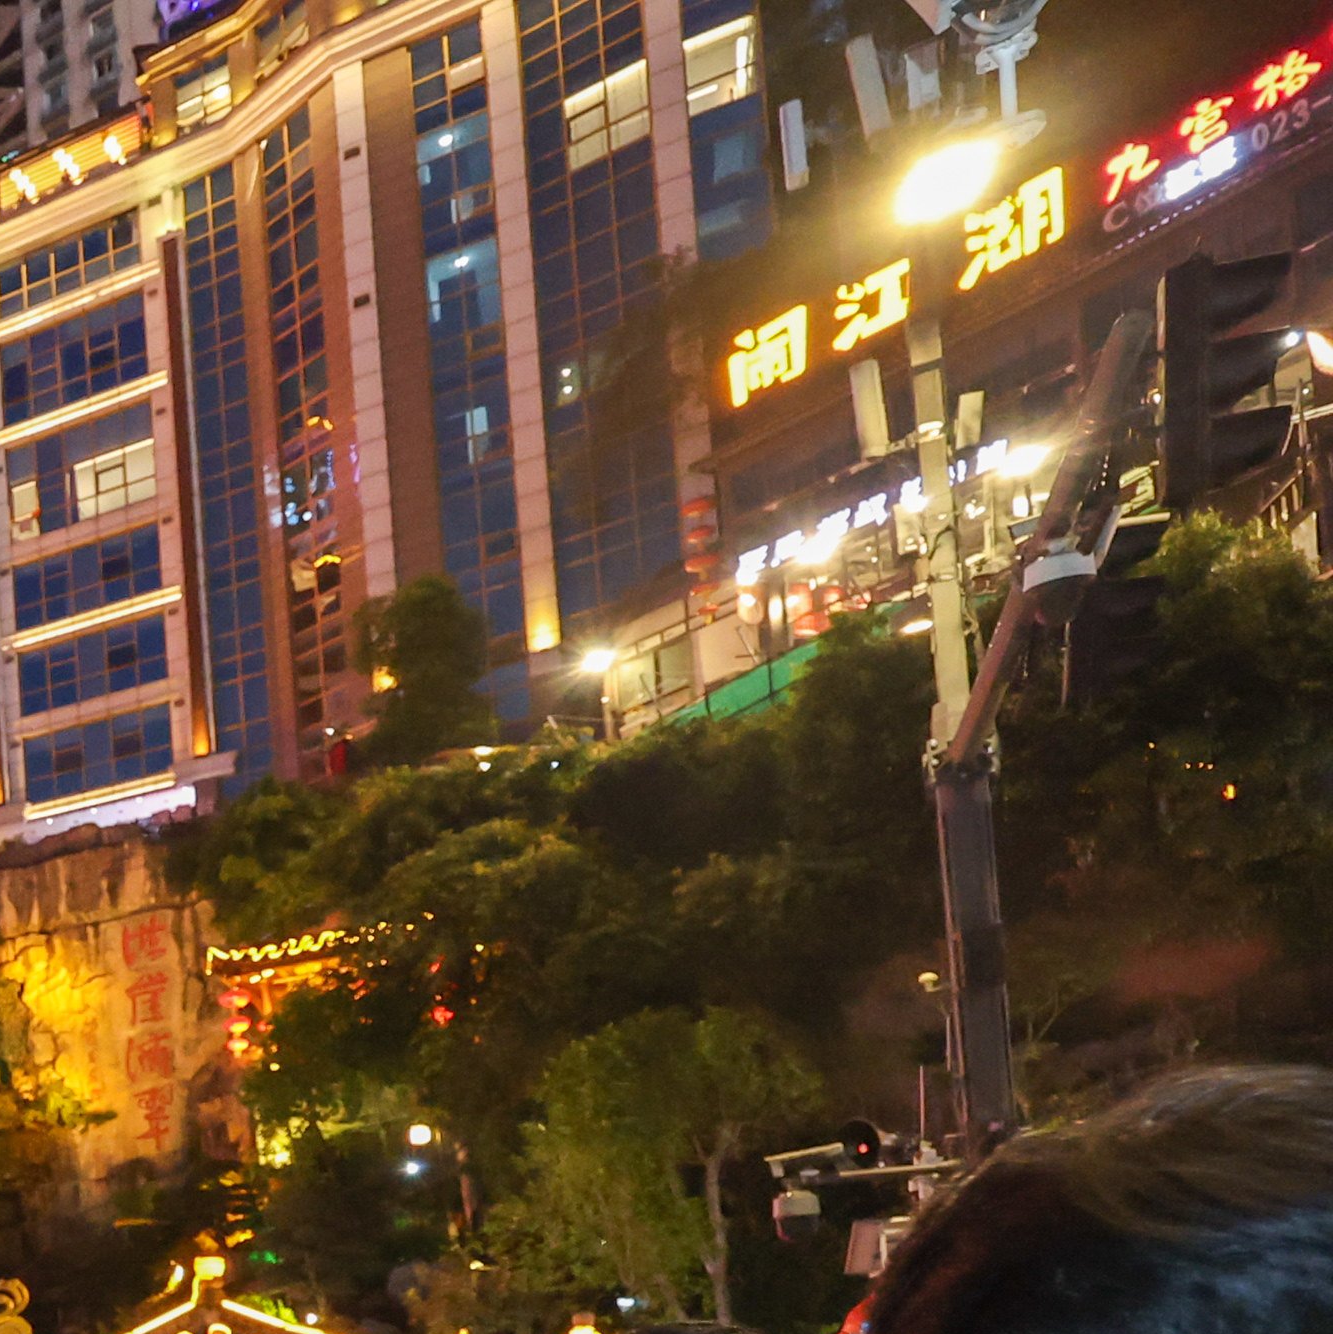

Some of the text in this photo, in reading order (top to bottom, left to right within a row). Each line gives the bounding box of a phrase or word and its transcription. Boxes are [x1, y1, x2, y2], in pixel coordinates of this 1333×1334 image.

[1105, 49, 1322, 204] 九宫格
[727, 166, 1065, 408] 闹江湖
